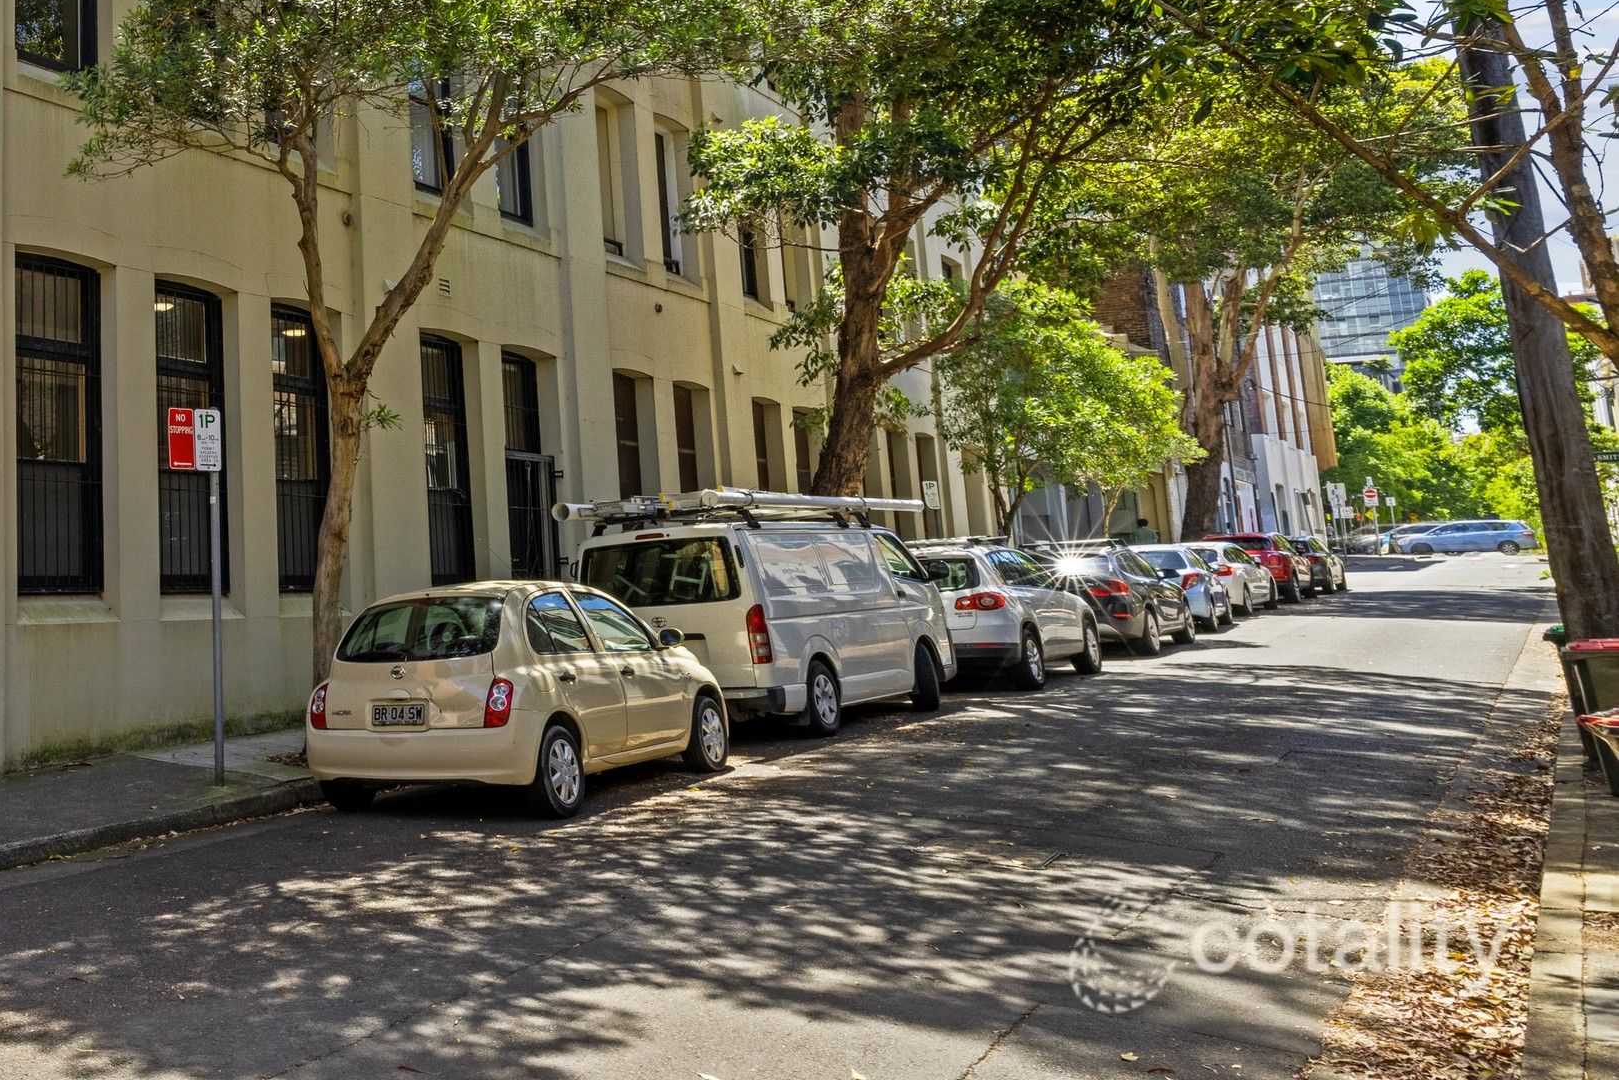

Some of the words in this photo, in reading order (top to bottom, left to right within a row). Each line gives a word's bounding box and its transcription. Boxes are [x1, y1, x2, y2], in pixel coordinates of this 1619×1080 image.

[175, 413, 186, 422] NO
[199, 414, 216, 428] 1P
[170, 425, 194, 434] STOPPING
[925, 482, 935, 490] 1P
